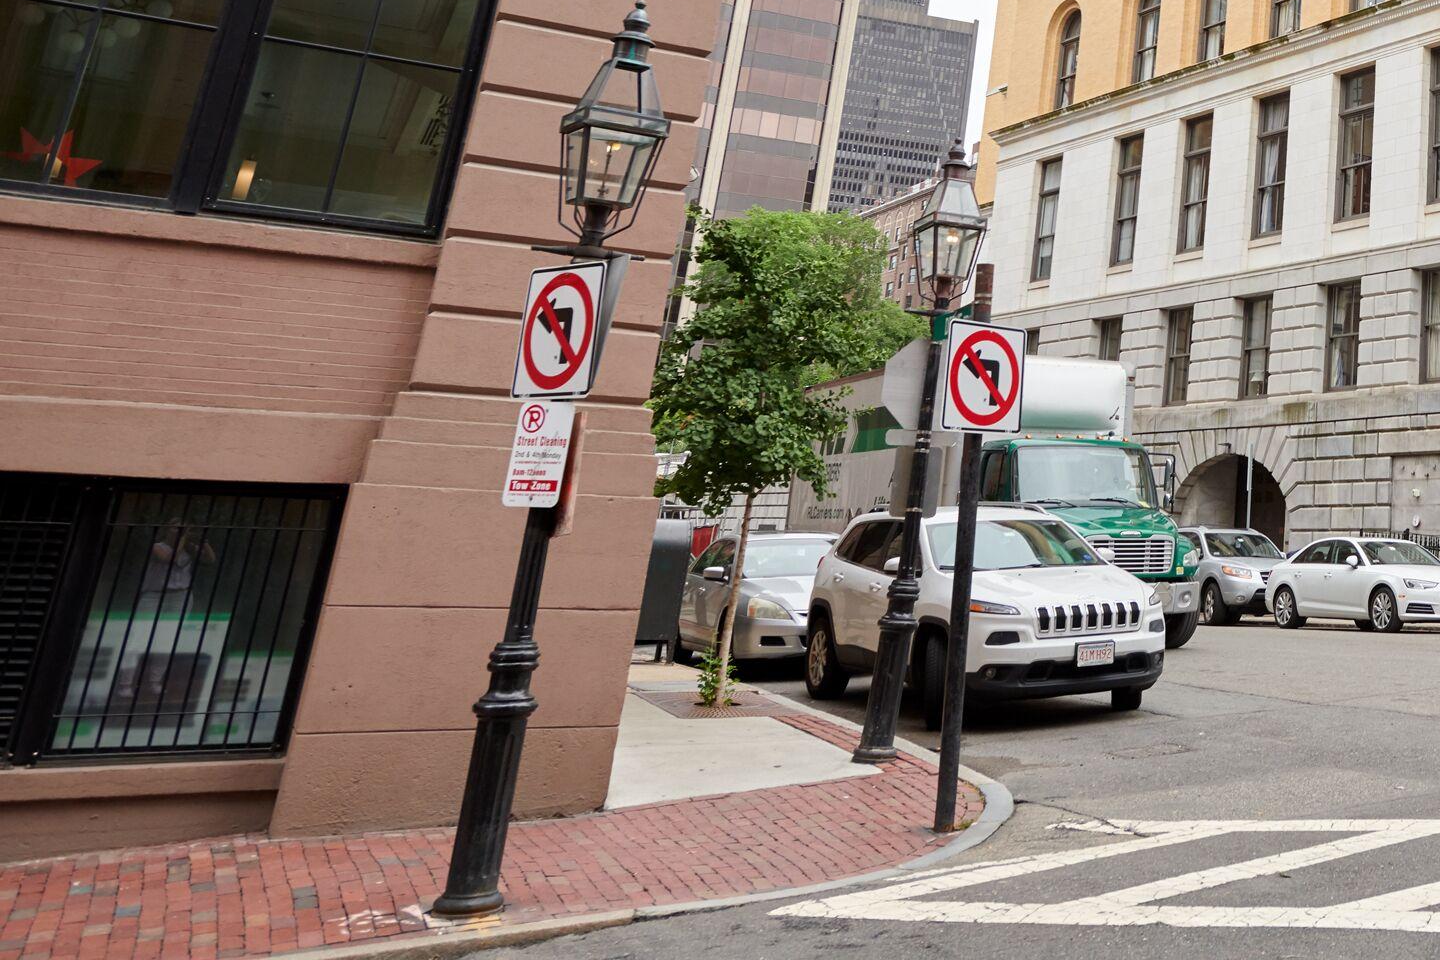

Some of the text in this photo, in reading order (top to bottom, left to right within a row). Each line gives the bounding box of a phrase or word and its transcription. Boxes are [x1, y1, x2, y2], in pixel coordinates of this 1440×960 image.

[517, 436, 567, 448] Street Cleaning
[514, 450, 525, 458] 2nd
[511, 481, 551, 491] Tow Zone
